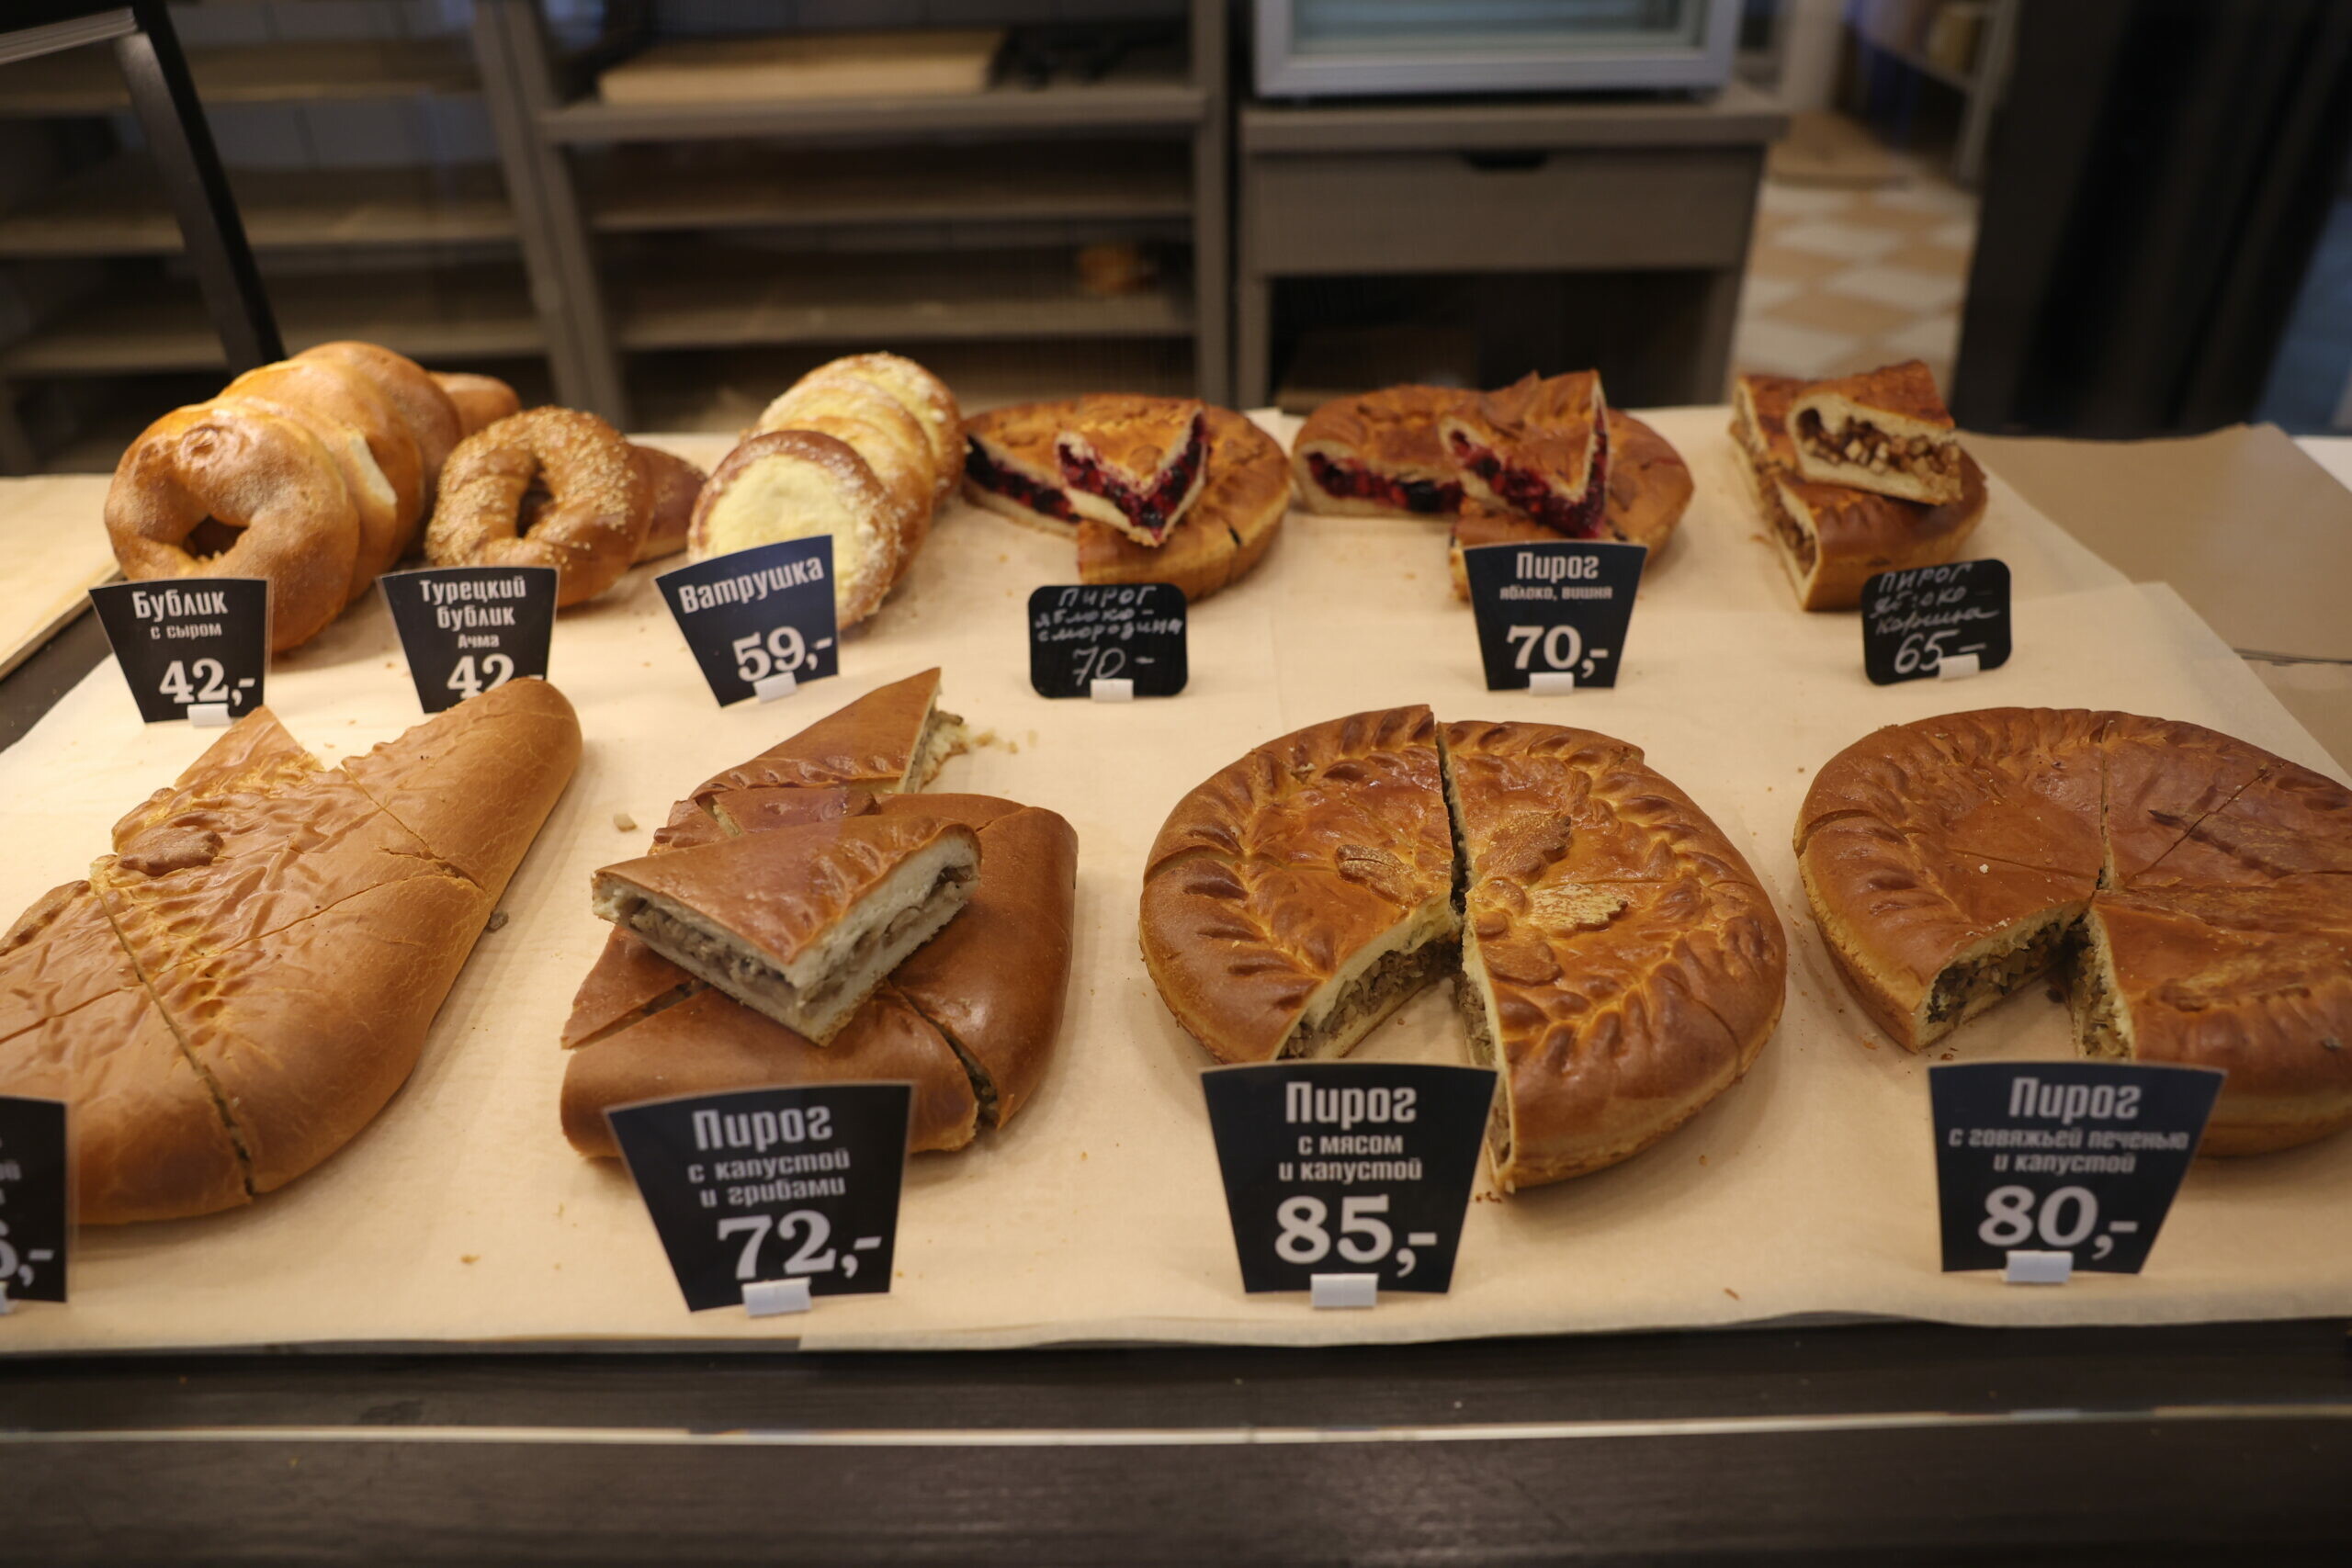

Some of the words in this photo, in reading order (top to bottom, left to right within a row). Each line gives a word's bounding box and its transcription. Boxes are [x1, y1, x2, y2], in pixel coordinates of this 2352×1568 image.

[1516, 552, 1600, 583] Пирог
[419, 576, 526, 605] Турецкий
[678, 557, 824, 615] Ватрушка
[1499, 584, 1557, 602] яблоко,
[1561, 586, 1613, 600] вишня
[131, 589, 228, 622] Бублик
[436, 605, 515, 631] бублик
[150, 626, 161, 639] с
[166, 623, 222, 640] сыром
[458, 634, 500, 649] Ачма
[732, 626, 832, 682] 59,-
[1507, 625, 1609, 678] 70,-
[159, 658, 255, 706] 42,-
[1286, 1082, 1416, 1130] Пирог
[2008, 1077, 2141, 1125] Пирог
[693, 1106, 832, 1152] Пирог
[1298, 1135, 1313, 1156] с
[1319, 1135, 1403, 1155] мясом
[1949, 1128, 1963, 1146] с
[1968, 1127, 2083, 1149] говяжьей
[2087, 1131, 2189, 1150] печенью
[688, 1164, 705, 1183] с
[715, 1148, 850, 1179] капустой
[1279, 1162, 1294, 1181] и
[1301, 1158, 1422, 1184] капустой
[1993, 1154, 2008, 1172] и
[2014, 1154, 2136, 1177] капустой
[699, 1190, 718, 1208] и
[728, 1177, 846, 1207] грибами
[1274, 1194, 1437, 1278] 85,-
[1978, 1185, 2138, 1261] 80,-
[718, 1210, 882, 1279] 72,-
